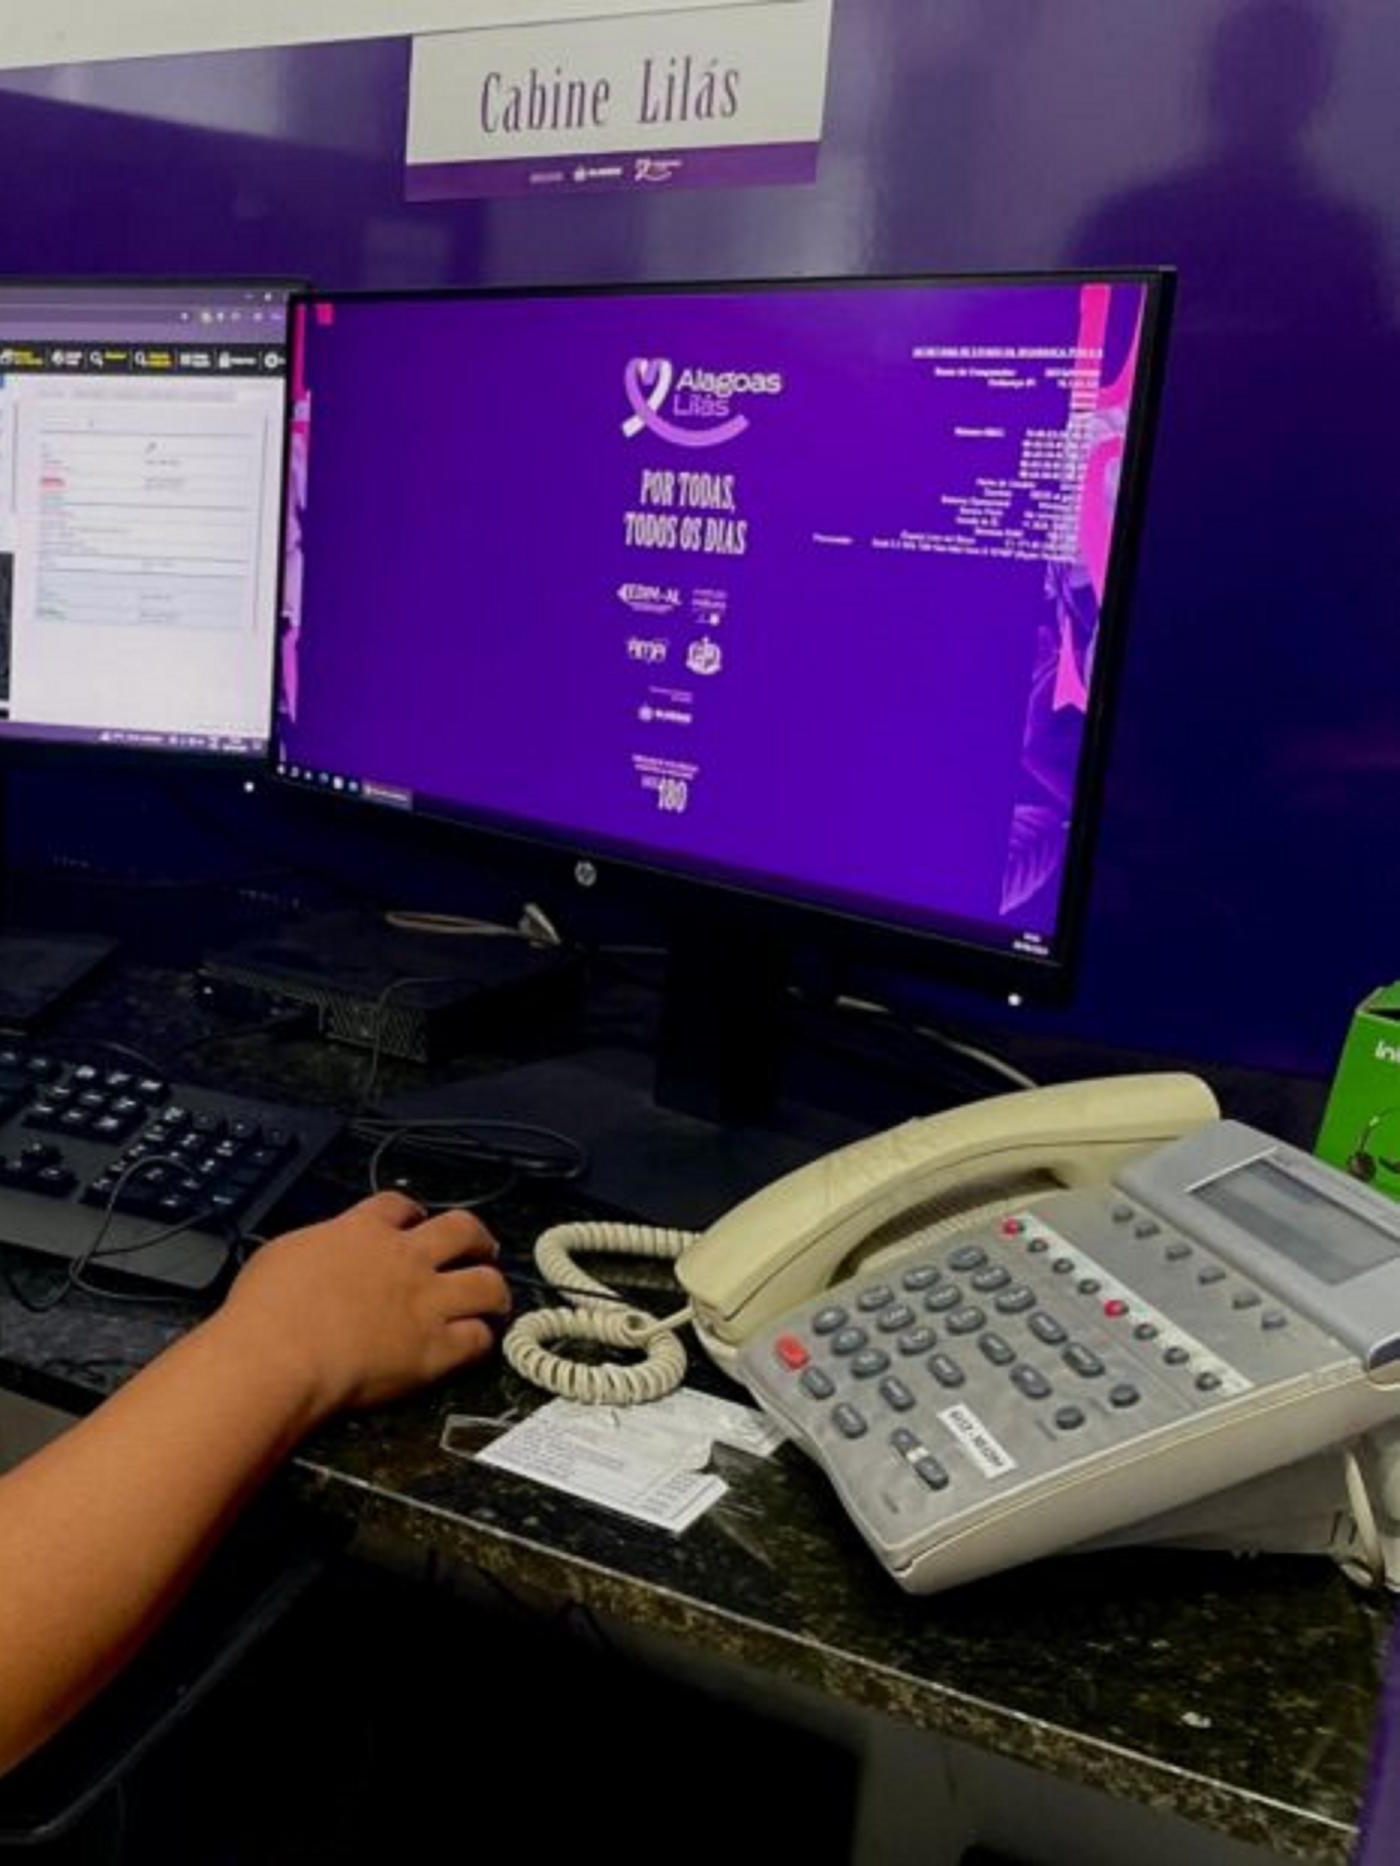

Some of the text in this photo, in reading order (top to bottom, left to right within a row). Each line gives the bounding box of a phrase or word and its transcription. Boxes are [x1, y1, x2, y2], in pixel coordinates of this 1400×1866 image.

[481, 55, 741, 134] Cabine Lilás
[676, 368, 783, 399] Alagoas
[640, 468, 736, 514] POR TODAS,
[623, 511, 748, 556] TODOS OS DIAS
